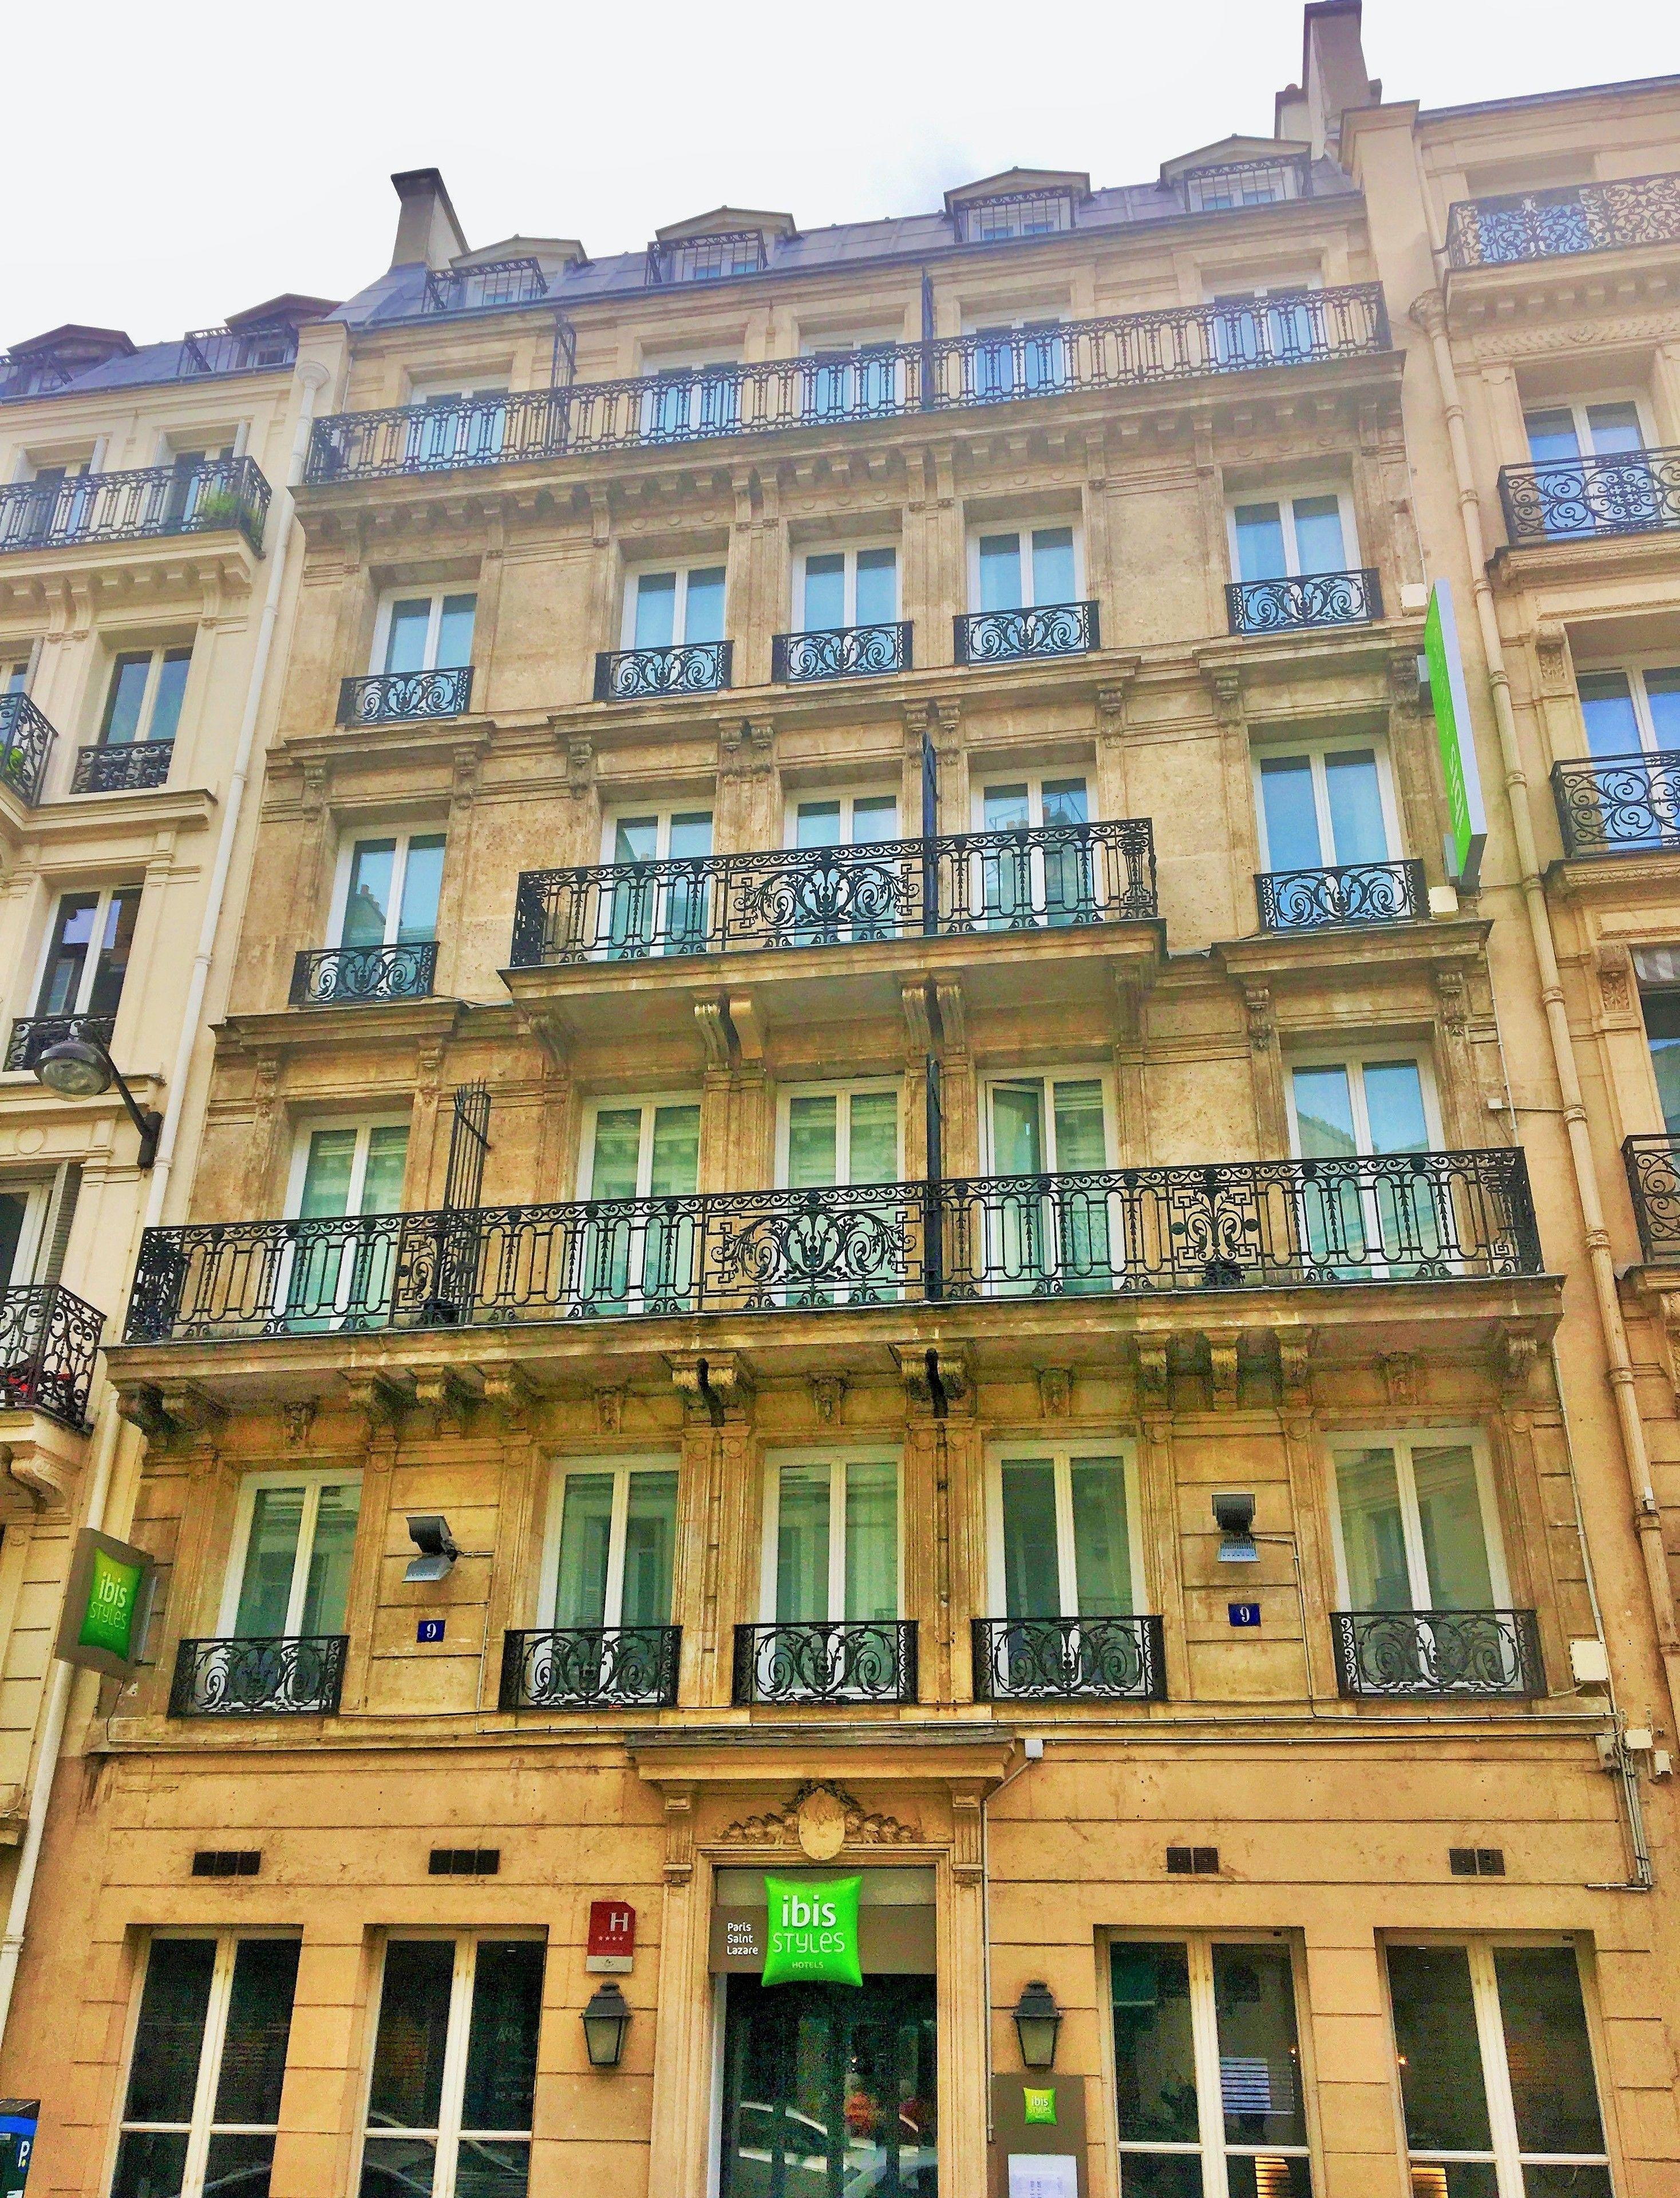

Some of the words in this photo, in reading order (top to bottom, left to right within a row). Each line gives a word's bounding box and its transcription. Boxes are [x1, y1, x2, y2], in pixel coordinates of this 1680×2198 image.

[98, 1570, 128, 1608] ibis
[1240, 1606, 1250, 1622] 9
[426, 1623, 437, 1638] 9
[782, 1894, 836, 1927] ibis
[610, 1912, 628, 1931] H
[728, 1922, 752, 1932] Paris
[727, 1933, 753, 1943] Saint
[726, 1946, 758, 1955] Lazare
[1031, 2096, 1049, 2106] ibis
